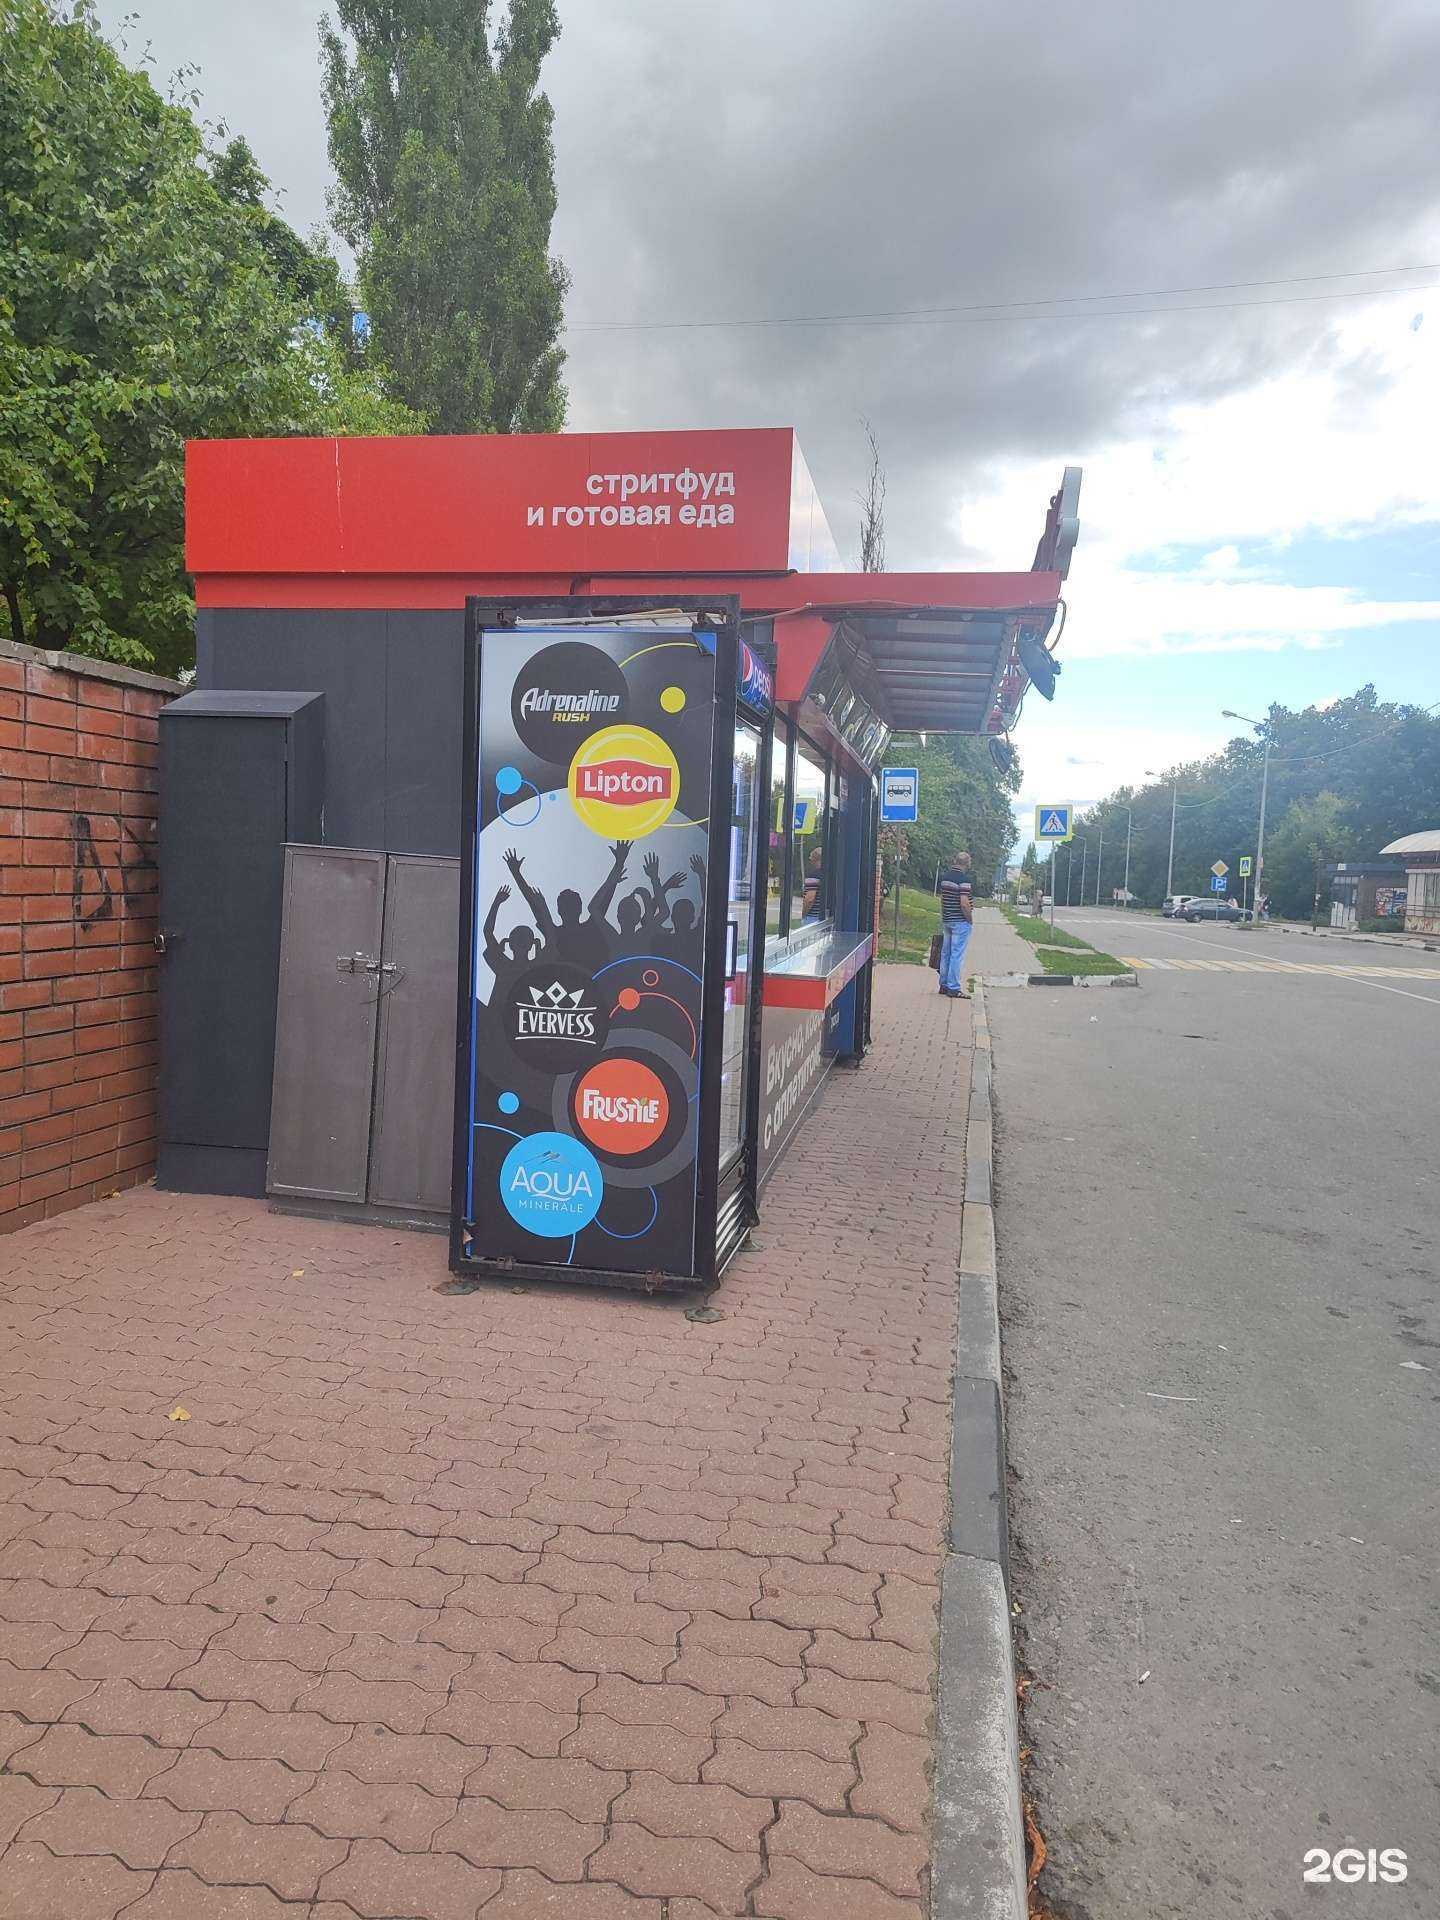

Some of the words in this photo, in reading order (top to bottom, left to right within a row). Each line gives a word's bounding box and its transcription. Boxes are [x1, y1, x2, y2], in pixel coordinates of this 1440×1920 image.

[586, 467, 735, 501] стритфуд
[527, 506, 544, 527] и
[552, 505, 671, 527] готовая
[678, 503, 735, 528] еда
[521, 687, 620, 721] Adrenaline
[552, 713, 591, 722] RUSH
[583, 770, 663, 798] Lipton
[518, 1008, 595, 1037] EVERVESS
[583, 1089, 659, 1124] FRUSTYLE
[510, 1166, 593, 1201] AQUA
[518, 1200, 584, 1214] MINERALE
